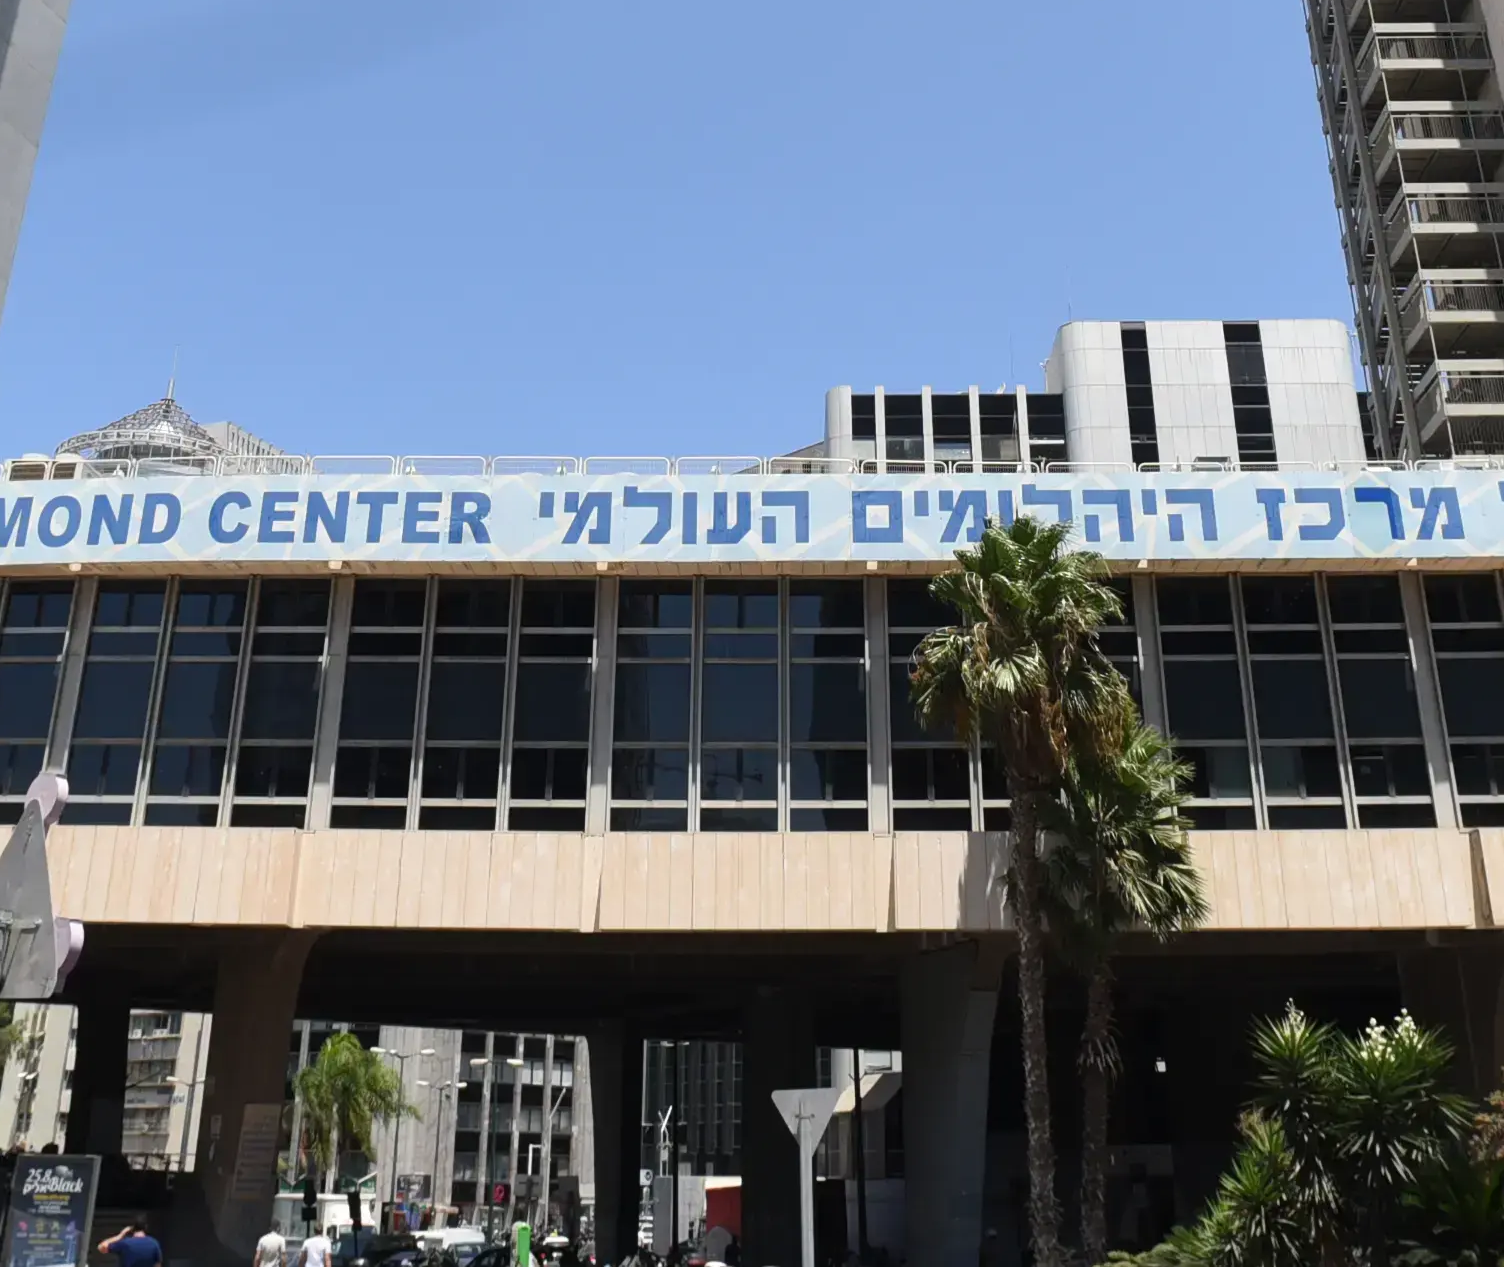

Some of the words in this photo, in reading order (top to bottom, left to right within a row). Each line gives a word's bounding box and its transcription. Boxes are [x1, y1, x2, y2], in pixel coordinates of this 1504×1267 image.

[209, 491, 492, 545] CENTER
[538, 488, 809, 544] העולמי
[852, 484, 1215, 543] היהלומים
[1259, 486, 1465, 541] מרכז
[51, 1176, 84, 1193] Black
